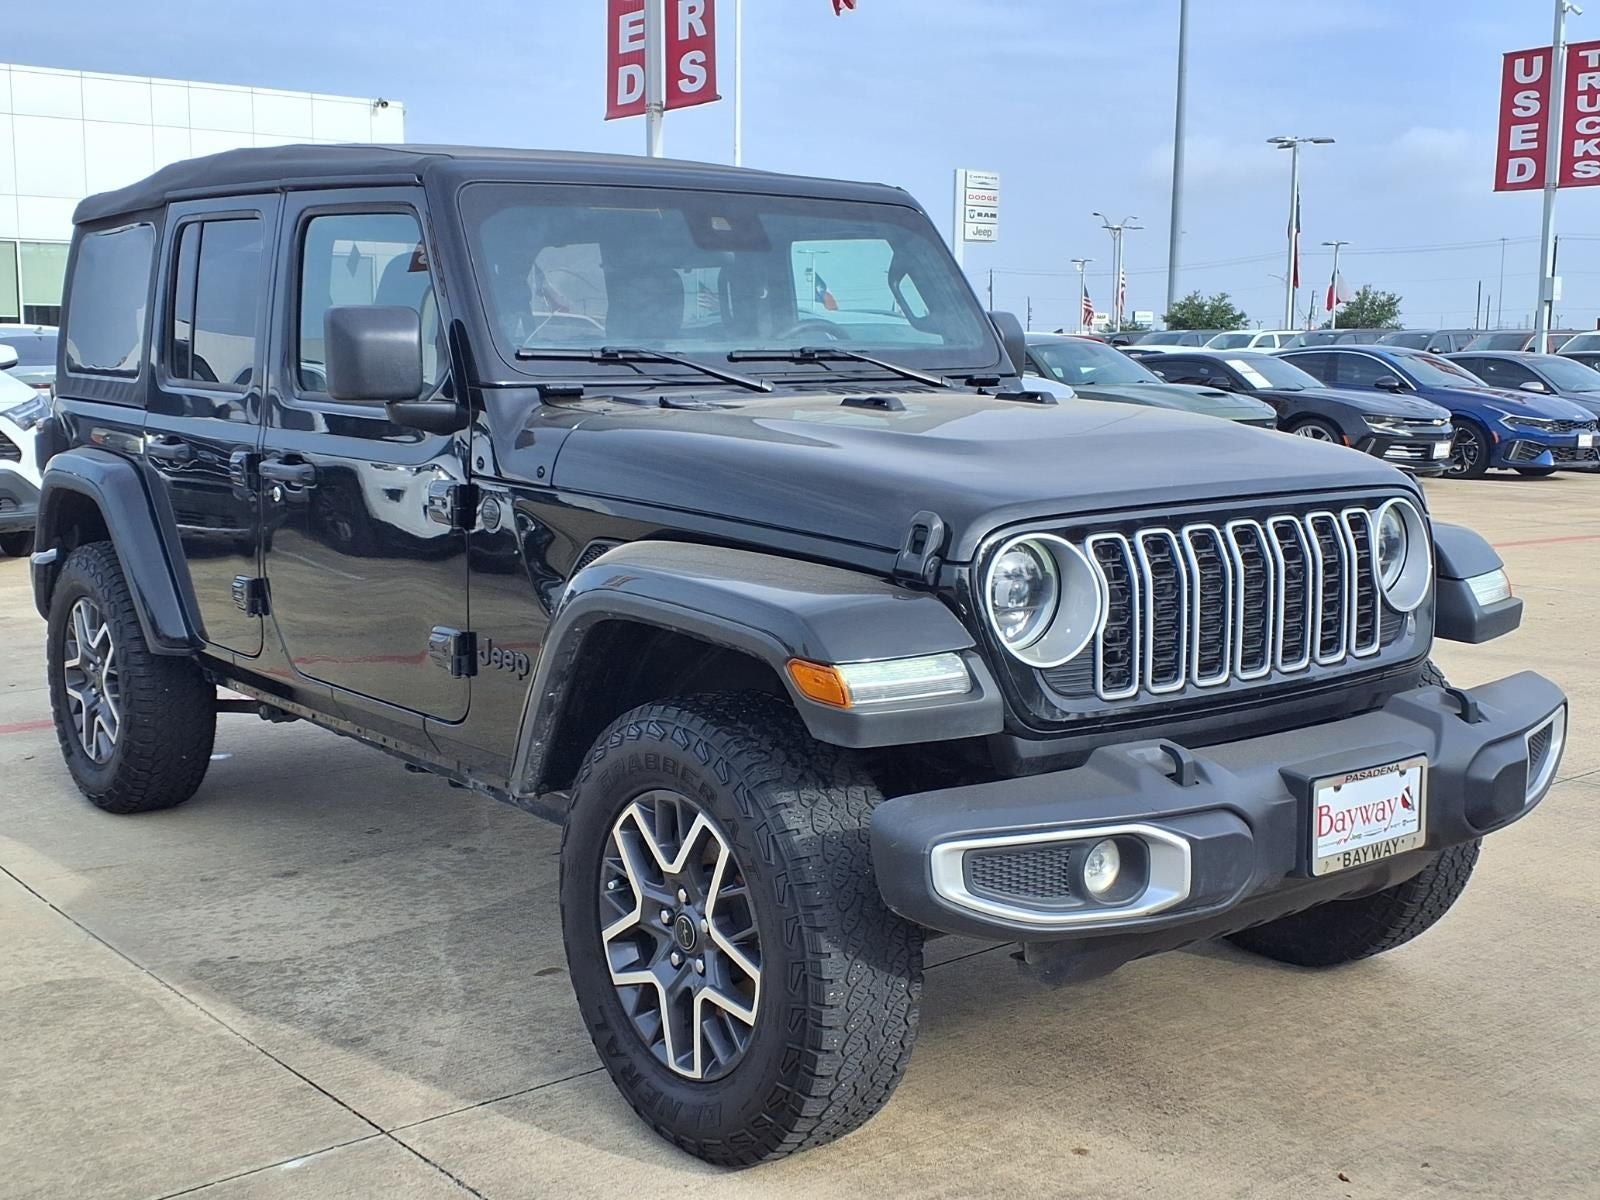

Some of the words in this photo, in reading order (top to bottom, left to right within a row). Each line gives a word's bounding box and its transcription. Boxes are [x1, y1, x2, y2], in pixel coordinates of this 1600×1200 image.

[617, 0, 645, 105] ED
[1506, 56, 1543, 184] USED
[1572, 48, 1600, 178] TRUCKS
[968, 194, 998, 202] DODGE
[977, 211, 997, 219] RAM
[972, 226, 992, 238] Jeep
[478, 637, 530, 681] Jeep
[1344, 763, 1401, 783] PASADENA
[1317, 796, 1398, 843] Bayway
[1342, 838, 1400, 868] BAYWAY
